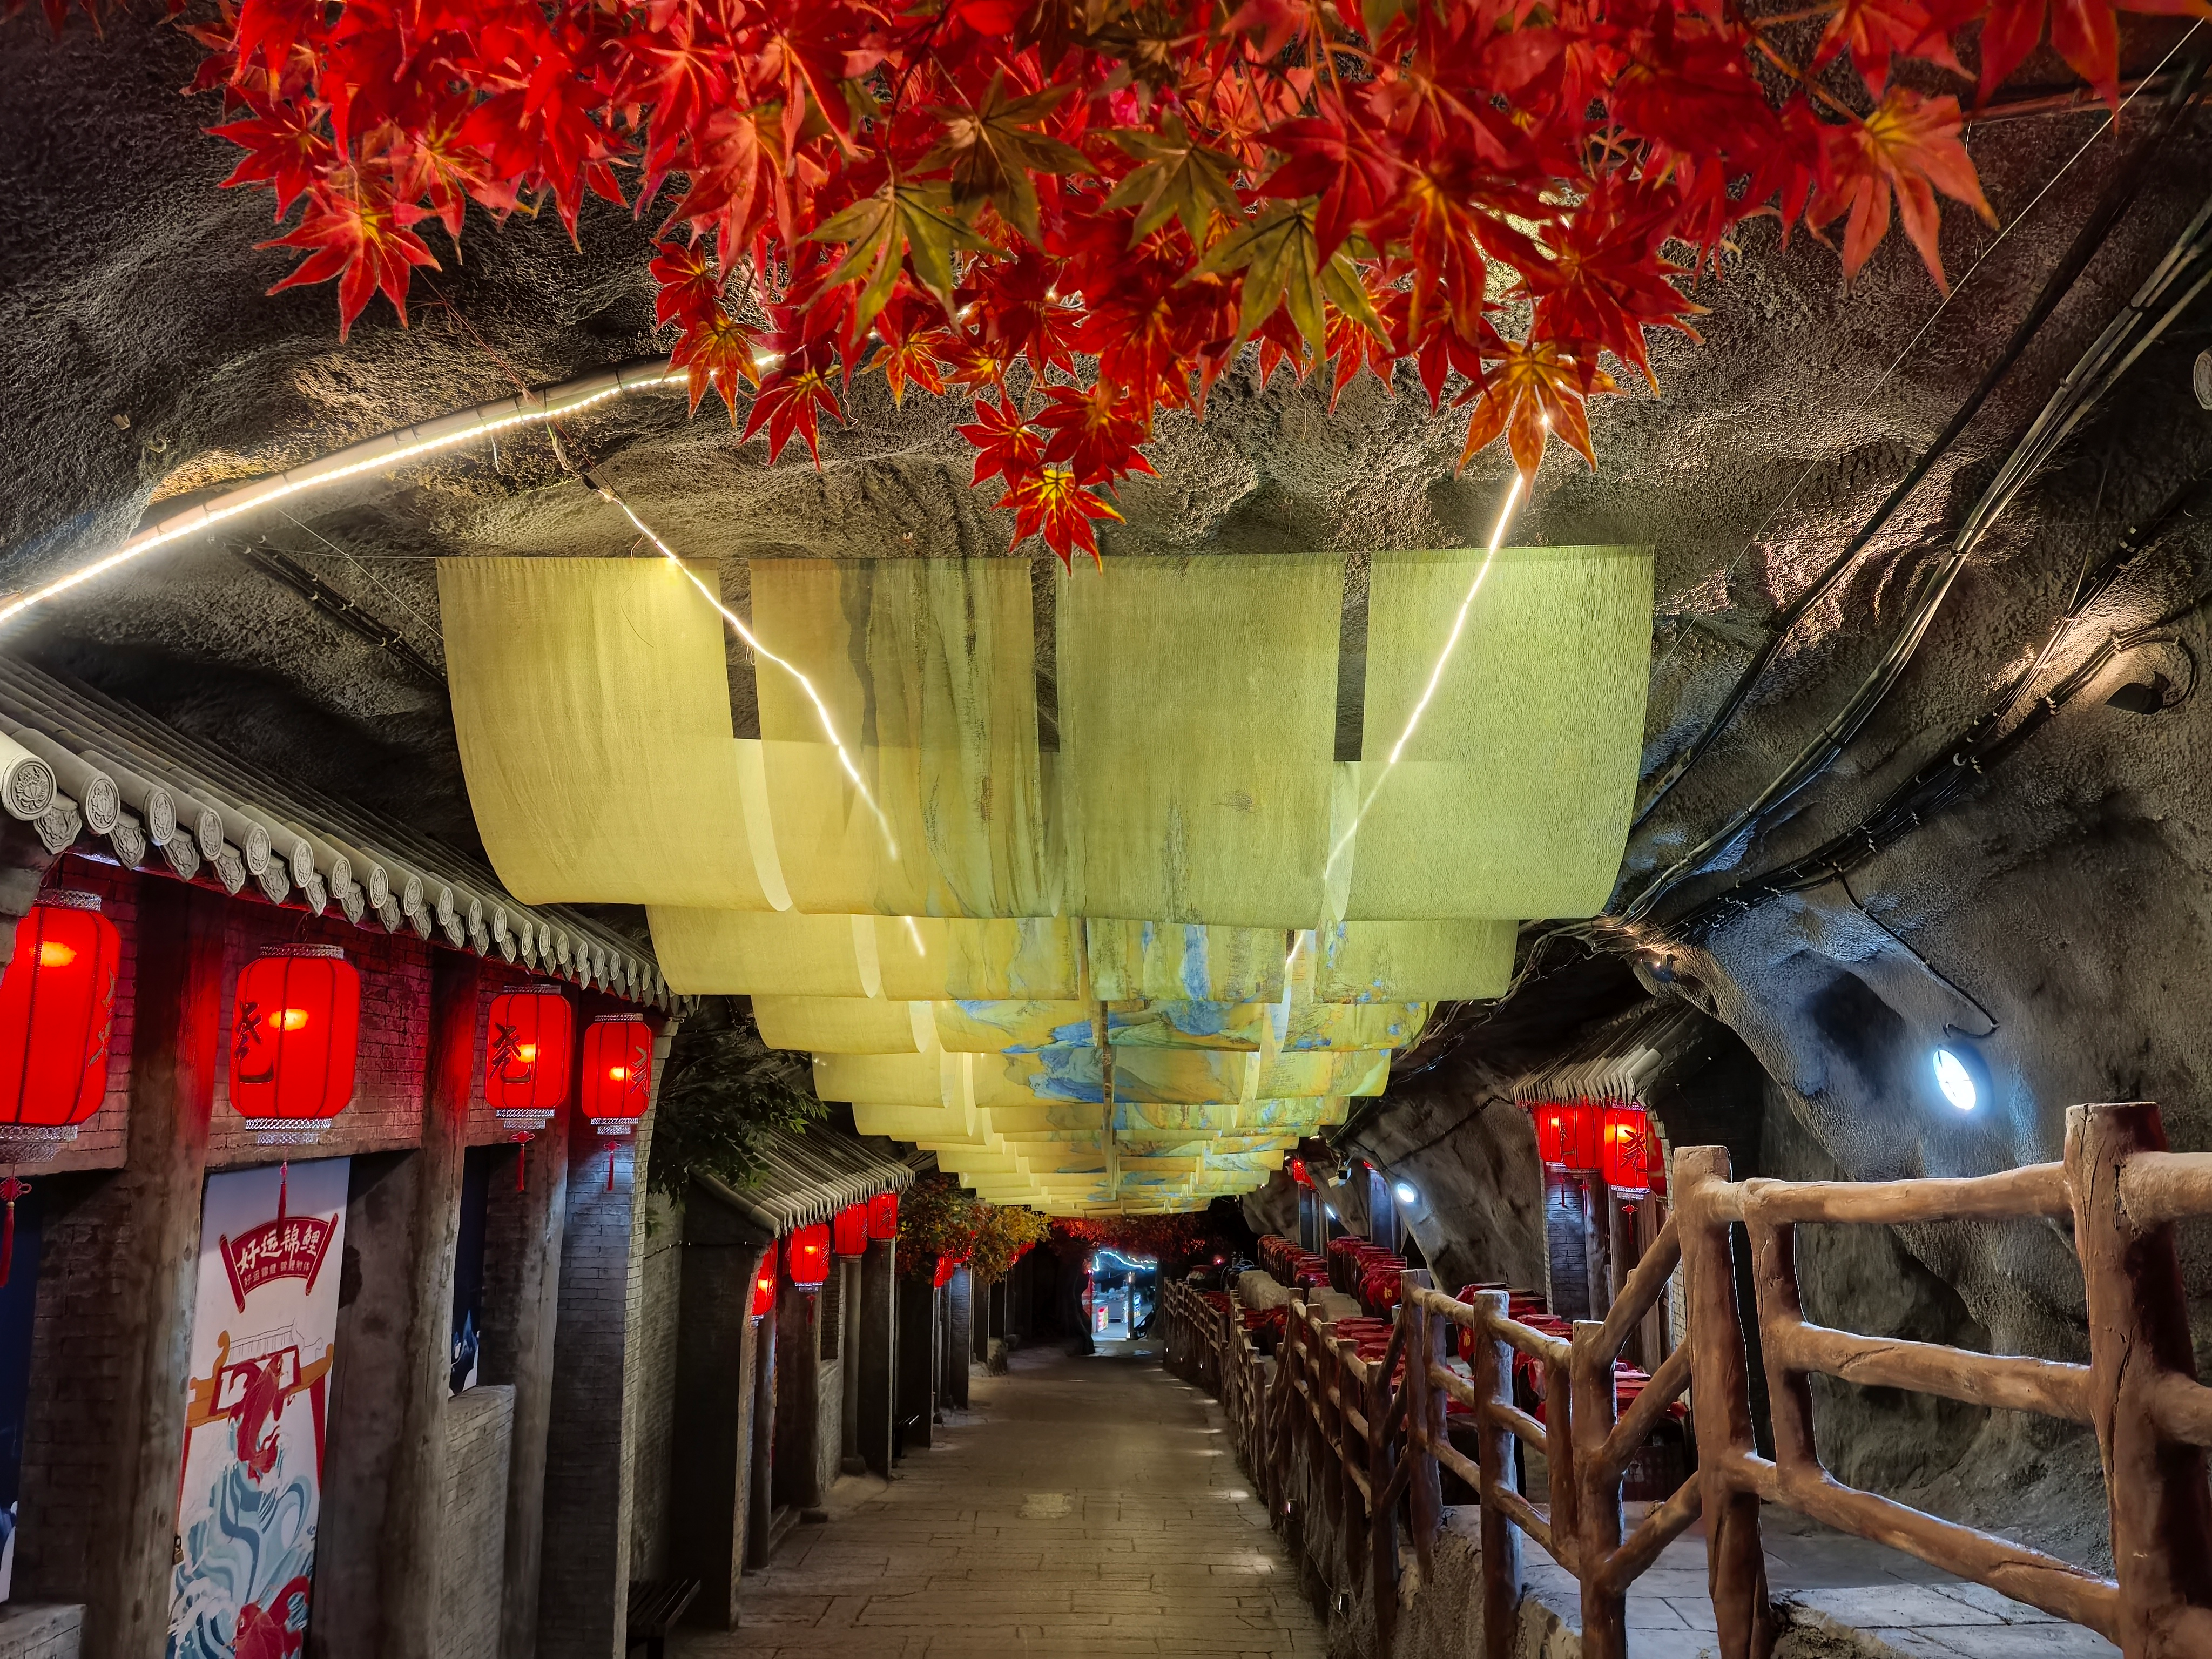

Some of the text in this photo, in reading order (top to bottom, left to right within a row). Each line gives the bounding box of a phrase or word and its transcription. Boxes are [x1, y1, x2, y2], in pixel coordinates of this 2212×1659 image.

[489, 1022, 531, 1084] 尧
[237, 1223, 321, 1276] 好运锦鲤
